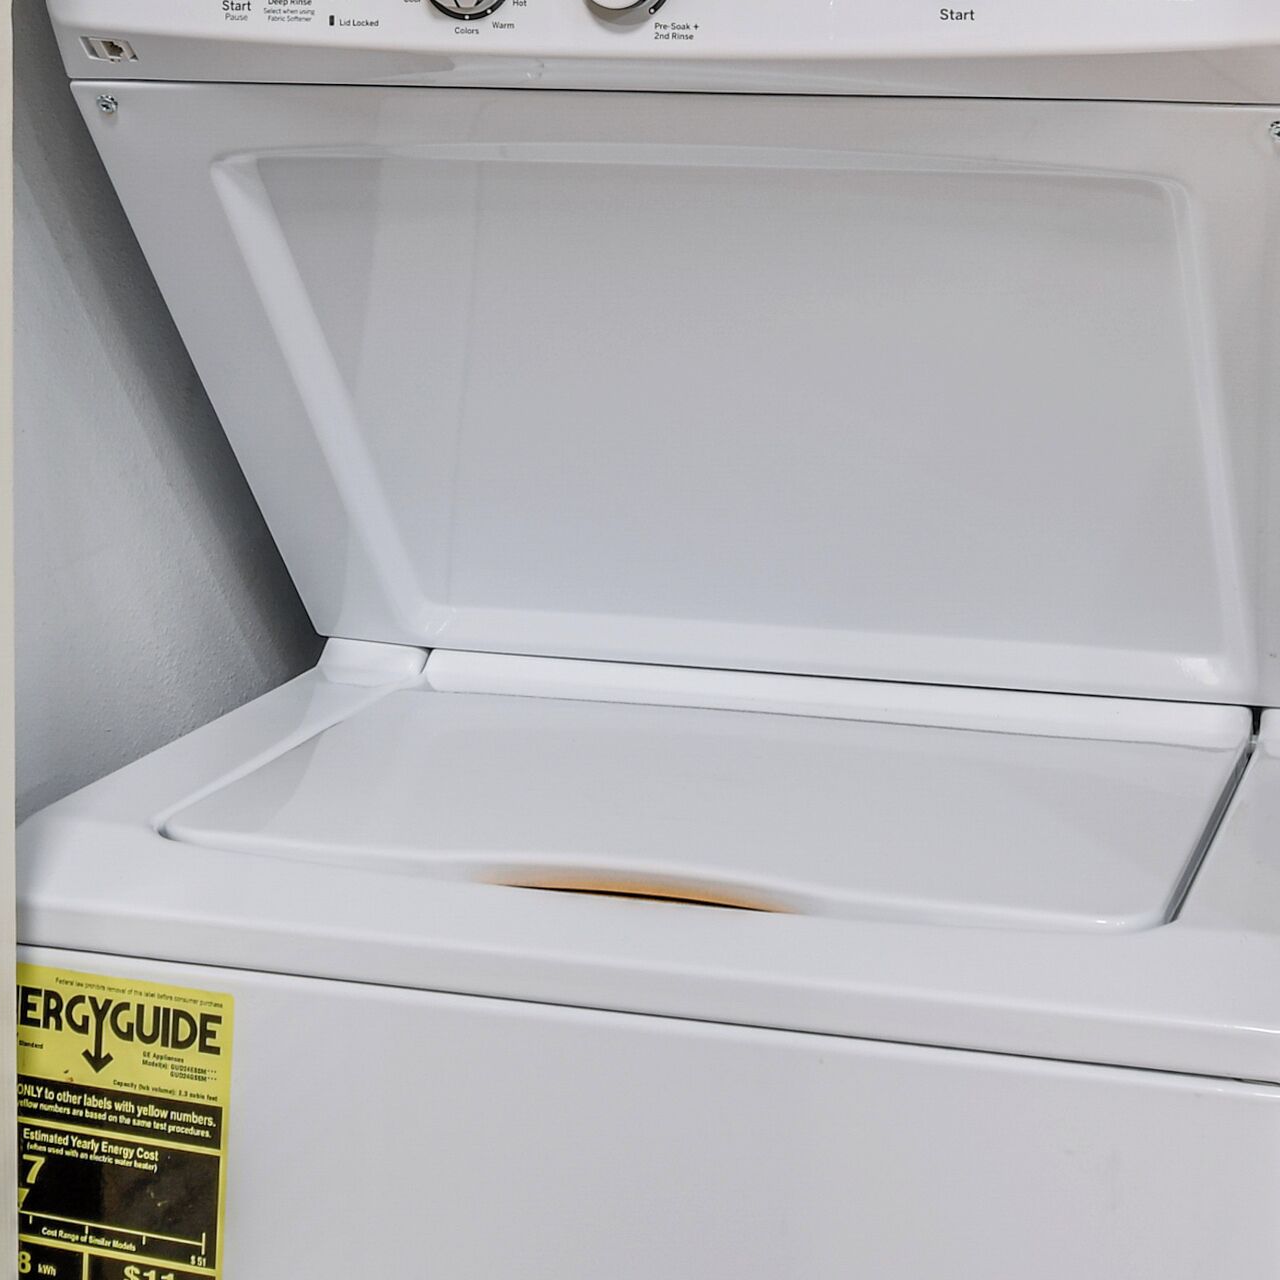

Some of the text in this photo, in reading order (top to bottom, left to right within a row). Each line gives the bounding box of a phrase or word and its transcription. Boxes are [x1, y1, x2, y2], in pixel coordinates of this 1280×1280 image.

[222, 0, 251, 11] Start
[225, 13, 248, 21] Pause
[940, 9, 975, 21] Start
[339, 19, 379, 27] Lid Locked
[654, 32, 694, 40] 2nd Rinse
[17, 985, 222, 1055] ERGYGUIDE
[113, 1080, 137, 1089] Capacity
[17, 1083, 216, 1127] ONLY to other labels with yellow numbers.
[40, 1103, 70, 1115] numbers
[85, 1109, 106, 1120] based
[119, 1115, 130, 1125] the
[132, 1119, 151, 1129] same
[153, 1121, 167, 1130] test
[168, 1124, 212, 1138] procedures.
[23, 1128, 159, 1161] Estimated Yearly Energy Cost
[48, 1146, 63, 1155] used
[65, 1149, 78, 1158] with
[89, 1153, 114, 1164] electric
[115, 1158, 133, 1167] water
[41, 1227, 58, 1237] Cost
[58, 1230, 79, 1242] Range
[80, 1235, 88, 1243] of
[112, 1240, 136, 1252] Models
[38, 1264, 56, 1276] kWh
